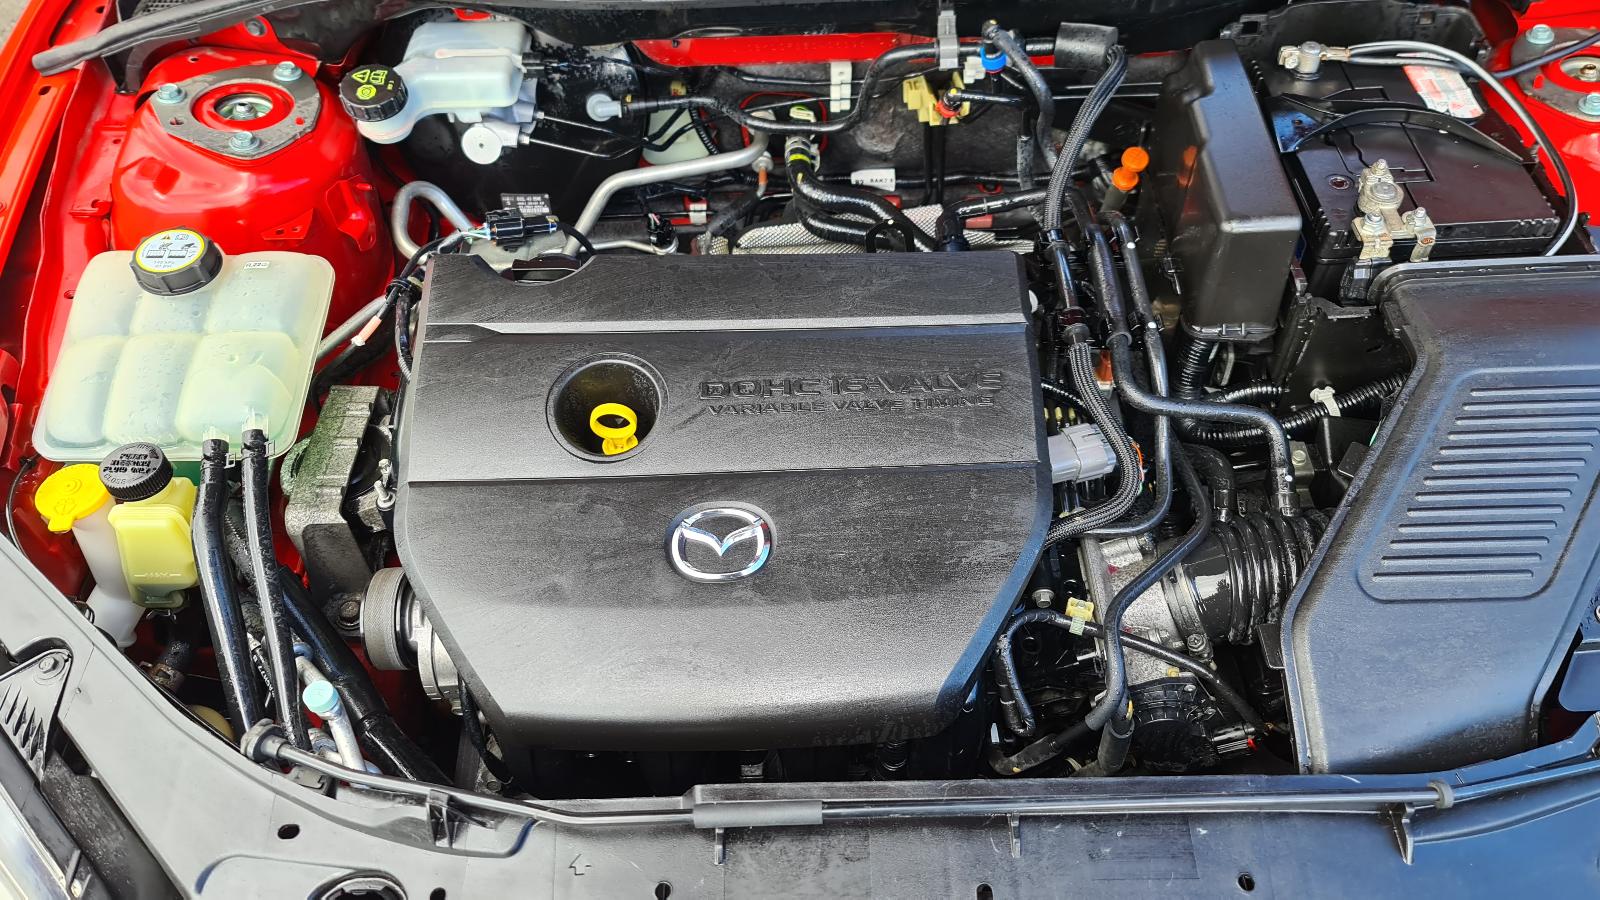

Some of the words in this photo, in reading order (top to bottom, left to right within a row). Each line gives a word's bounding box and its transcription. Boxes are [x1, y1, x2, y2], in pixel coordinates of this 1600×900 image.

[700, 379, 822, 399] DOHC
[707, 401, 826, 416] VARIABLE
[830, 398, 903, 412] VALVE
